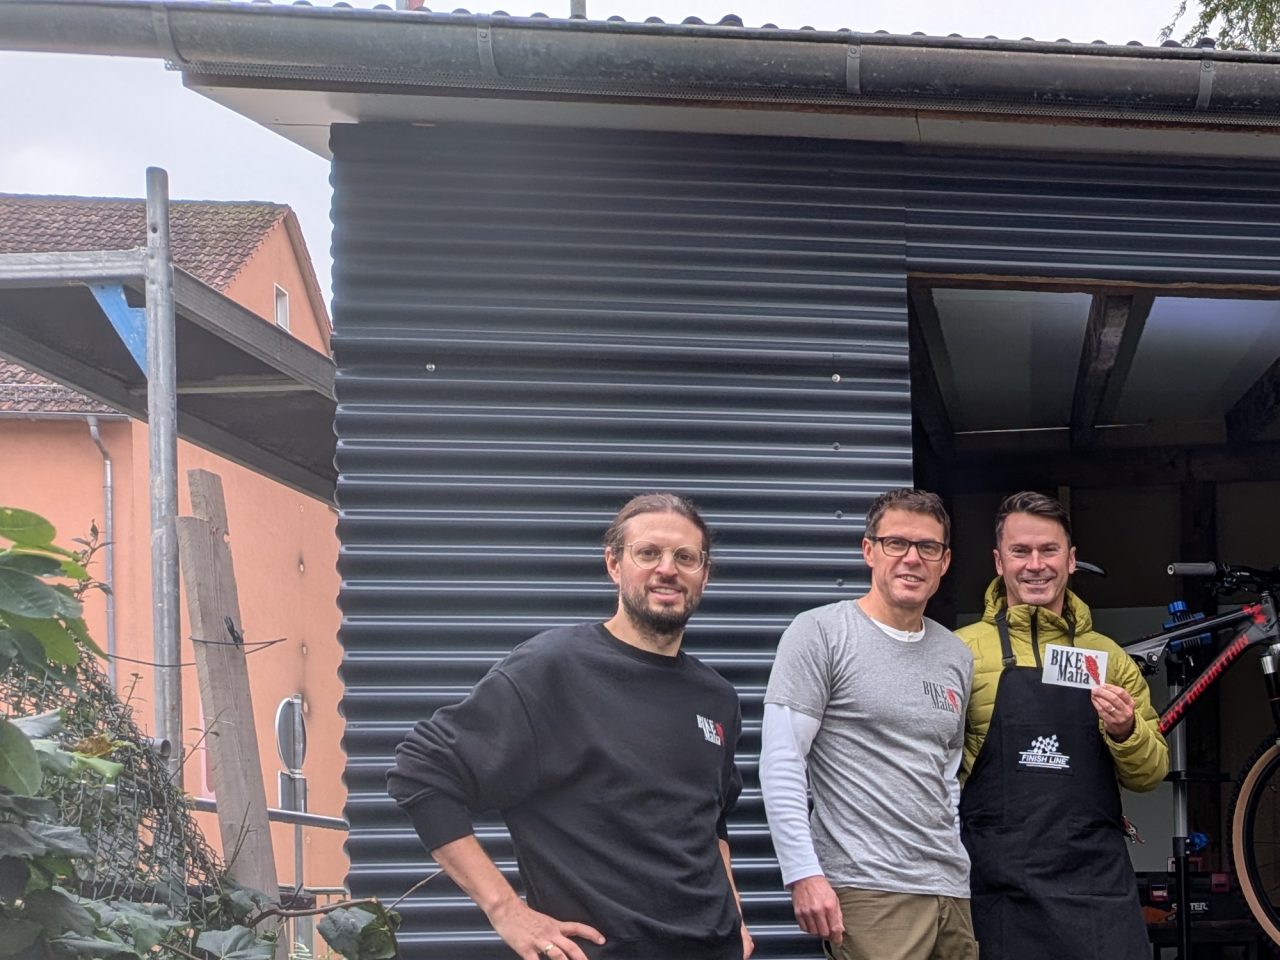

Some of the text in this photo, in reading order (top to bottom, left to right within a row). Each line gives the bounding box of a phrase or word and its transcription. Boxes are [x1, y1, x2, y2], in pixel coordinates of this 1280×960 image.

[1051, 649, 1083, 669] BIKE
[1057, 664, 1090, 684] Mafia
[923, 681, 946, 699] BIKE
[1021, 754, 1069, 765] FINISH LINE
